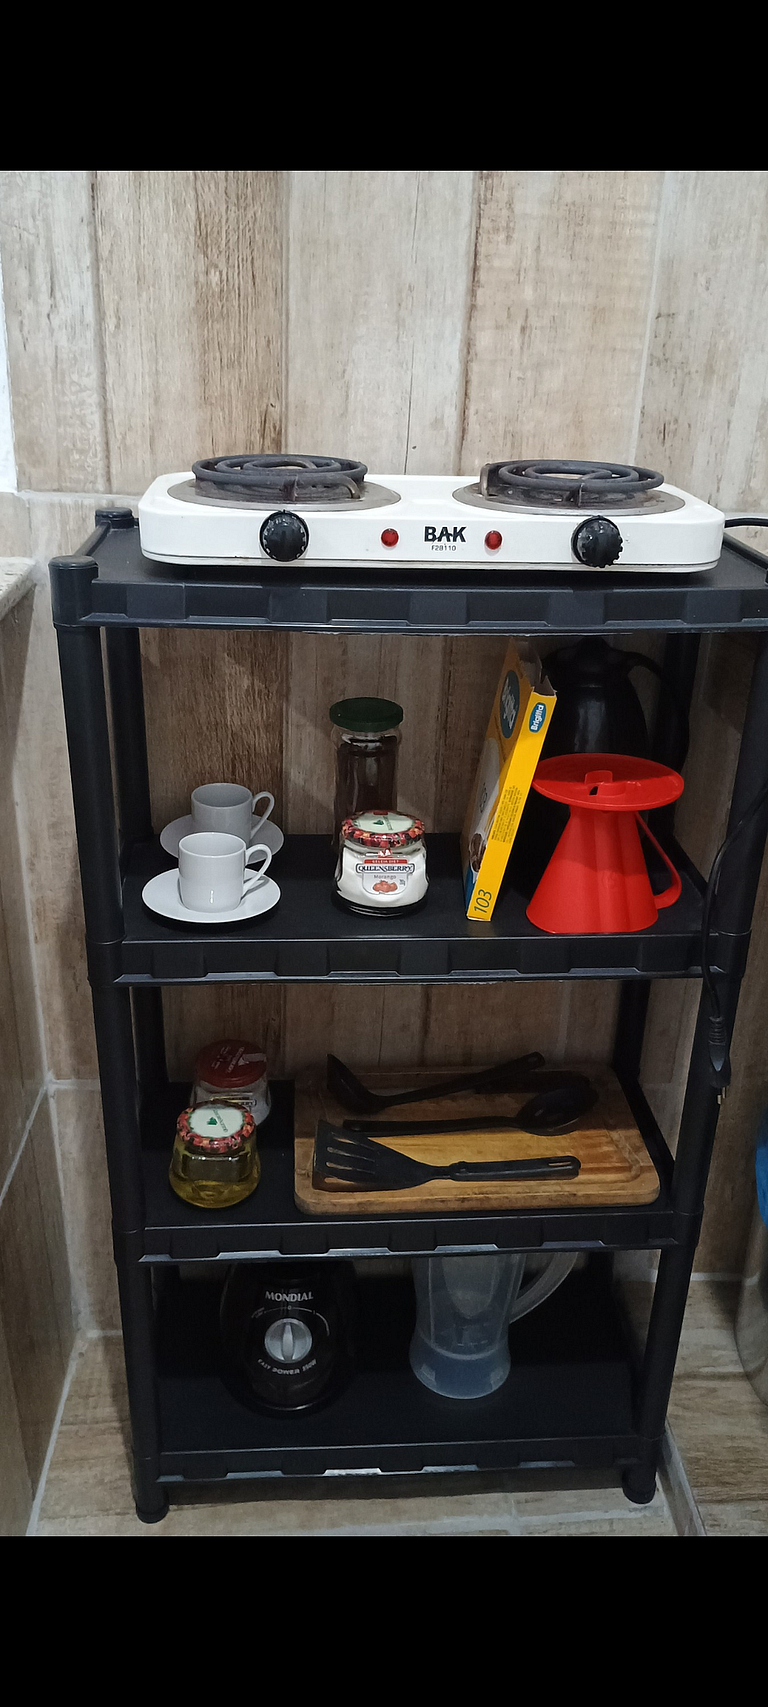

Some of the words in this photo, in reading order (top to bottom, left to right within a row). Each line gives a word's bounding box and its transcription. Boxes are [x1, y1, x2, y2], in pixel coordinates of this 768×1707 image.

[424, 526, 467, 543] BAK
[530, 703, 545, 731] Brigitta
[358, 865, 414, 873] QUEENSBERRY
[474, 889, 492, 914] 103
[265, 1291, 314, 1302] MONDIAL
[272, 1367, 300, 1375] POWER
